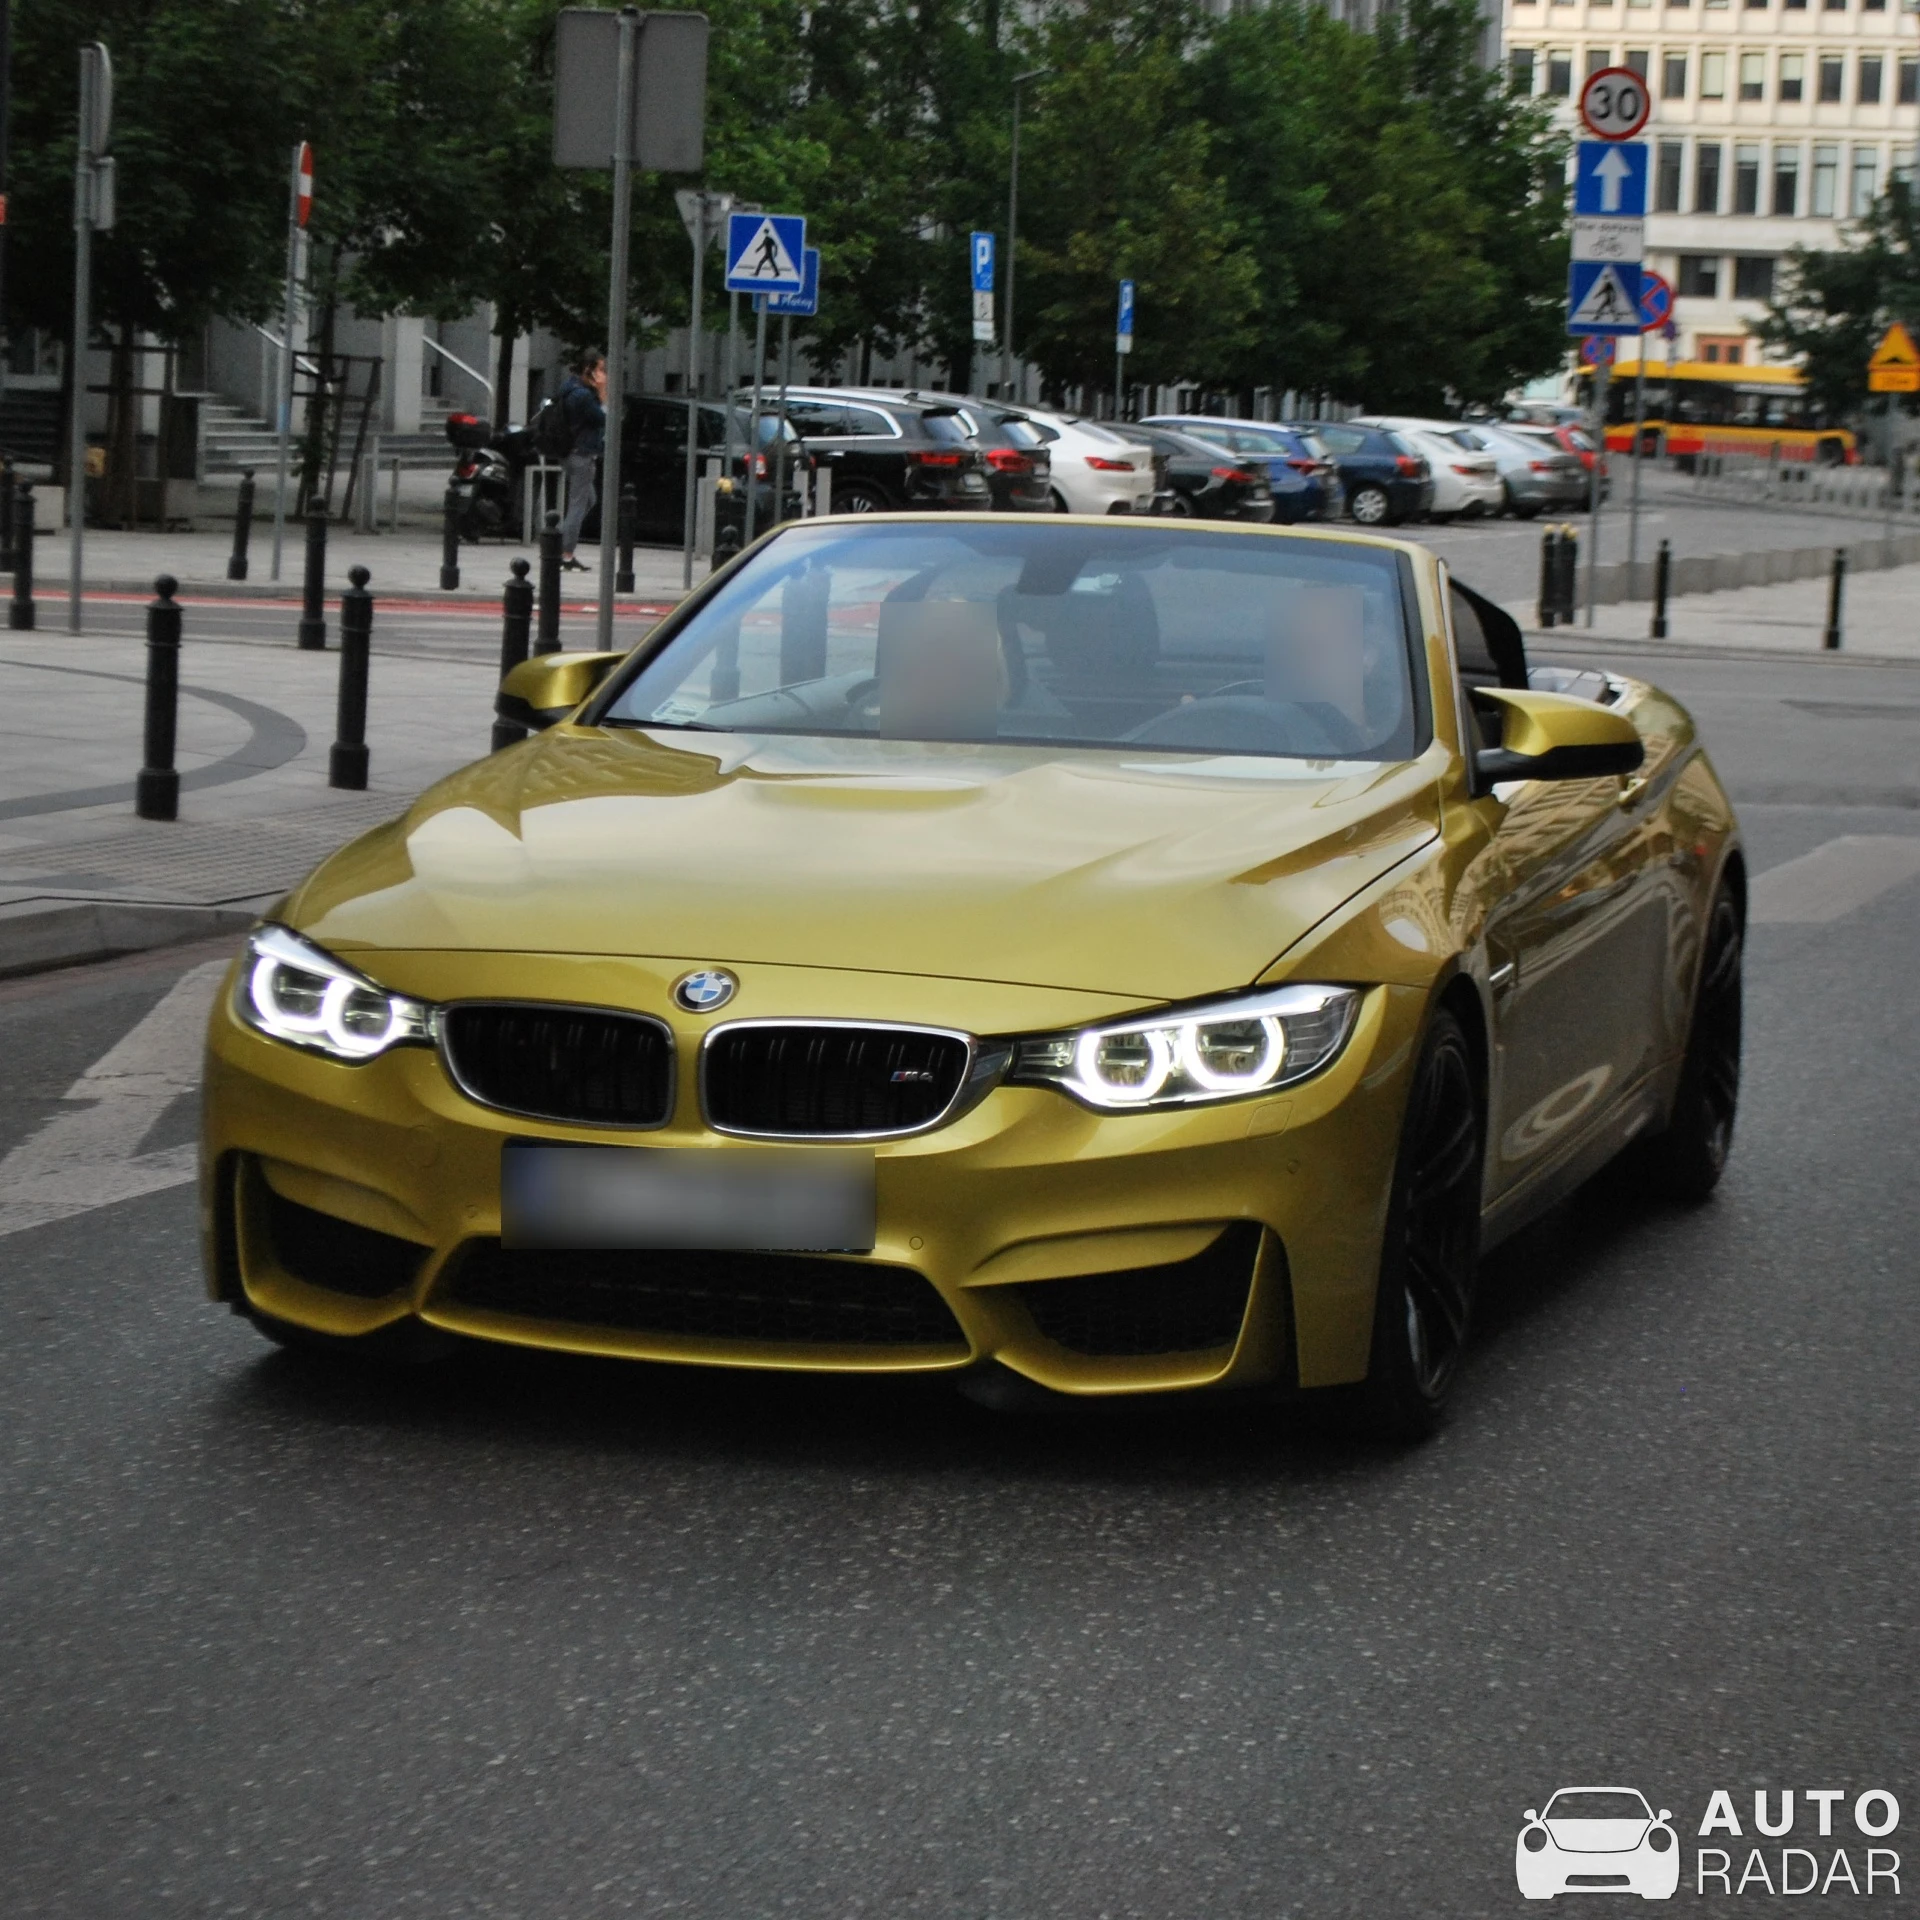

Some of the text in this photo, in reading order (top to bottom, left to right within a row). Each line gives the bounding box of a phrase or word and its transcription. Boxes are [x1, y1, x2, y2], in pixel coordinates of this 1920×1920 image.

[1591, 86, 1639, 122] 30
[976, 237, 991, 274] P
[684, 971, 731, 986] BMW
